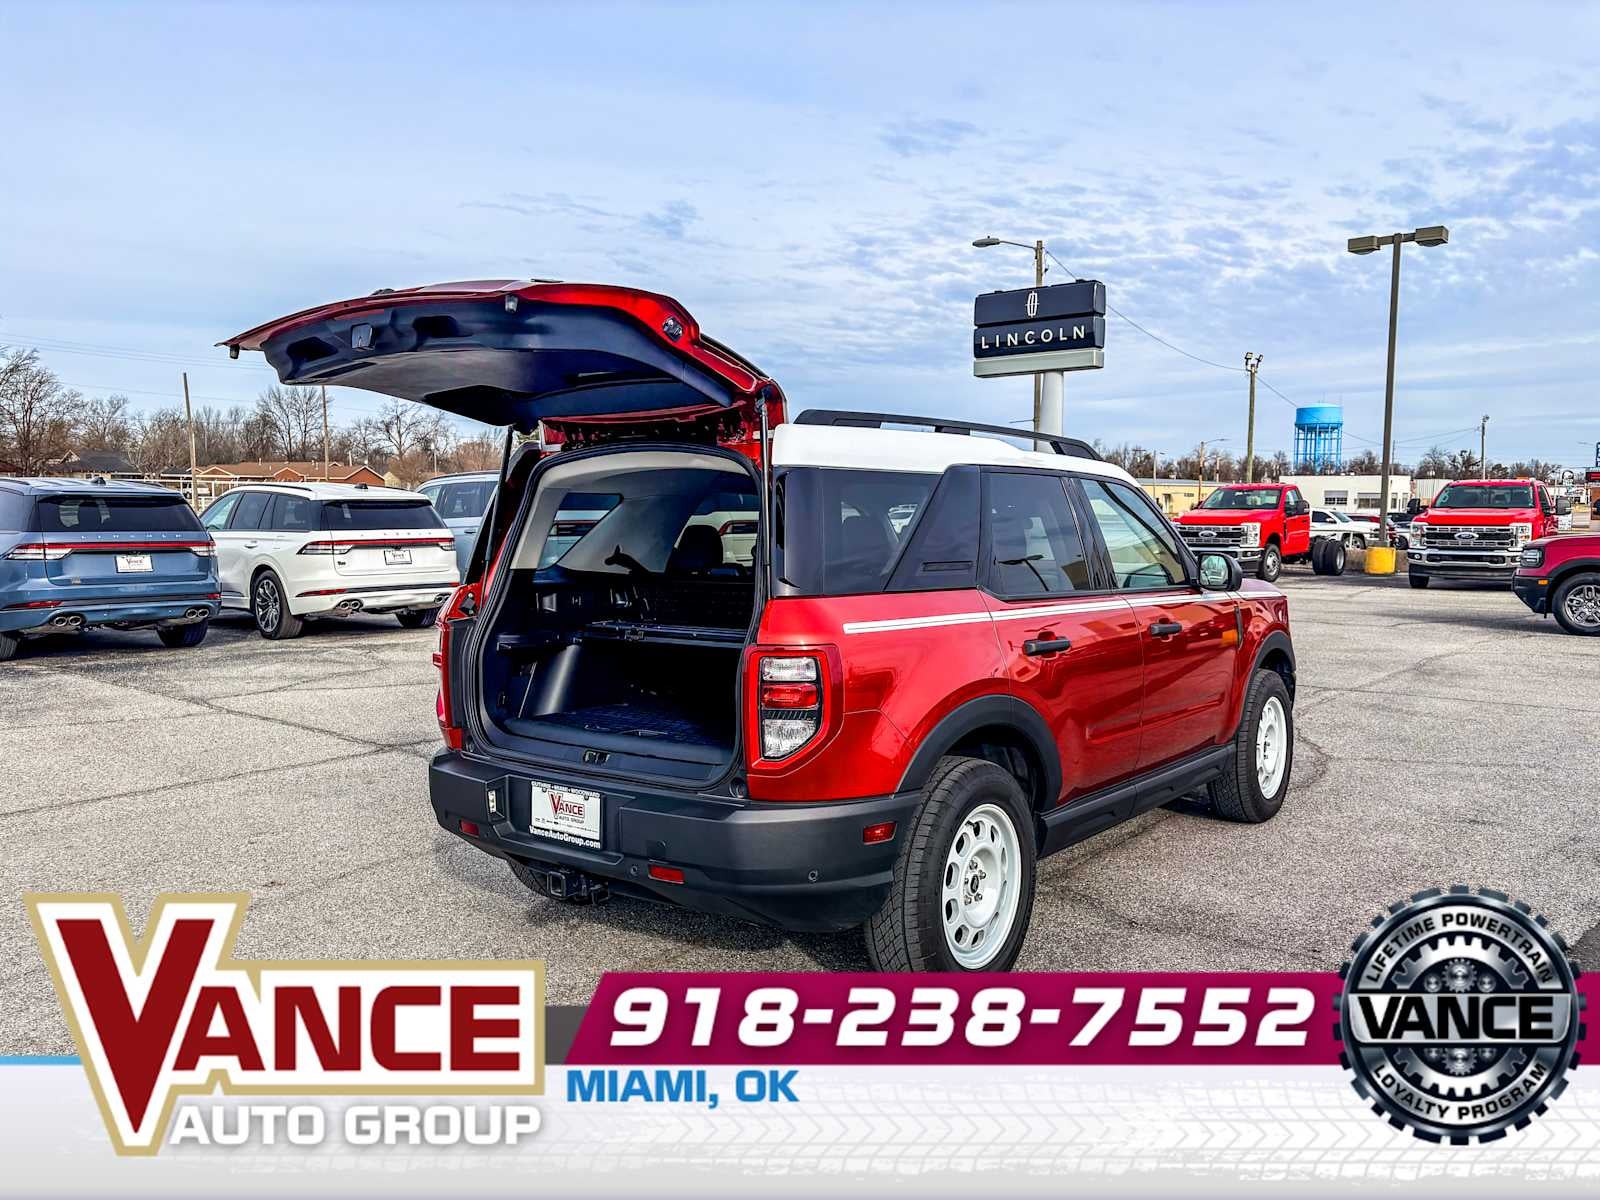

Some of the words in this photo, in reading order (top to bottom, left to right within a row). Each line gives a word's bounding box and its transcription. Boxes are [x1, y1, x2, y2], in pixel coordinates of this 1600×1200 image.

[981, 325, 1085, 349] LINCOLN
[550, 793, 583, 816] VANCE
[529, 825, 601, 849] VanceAutoGroup.com
